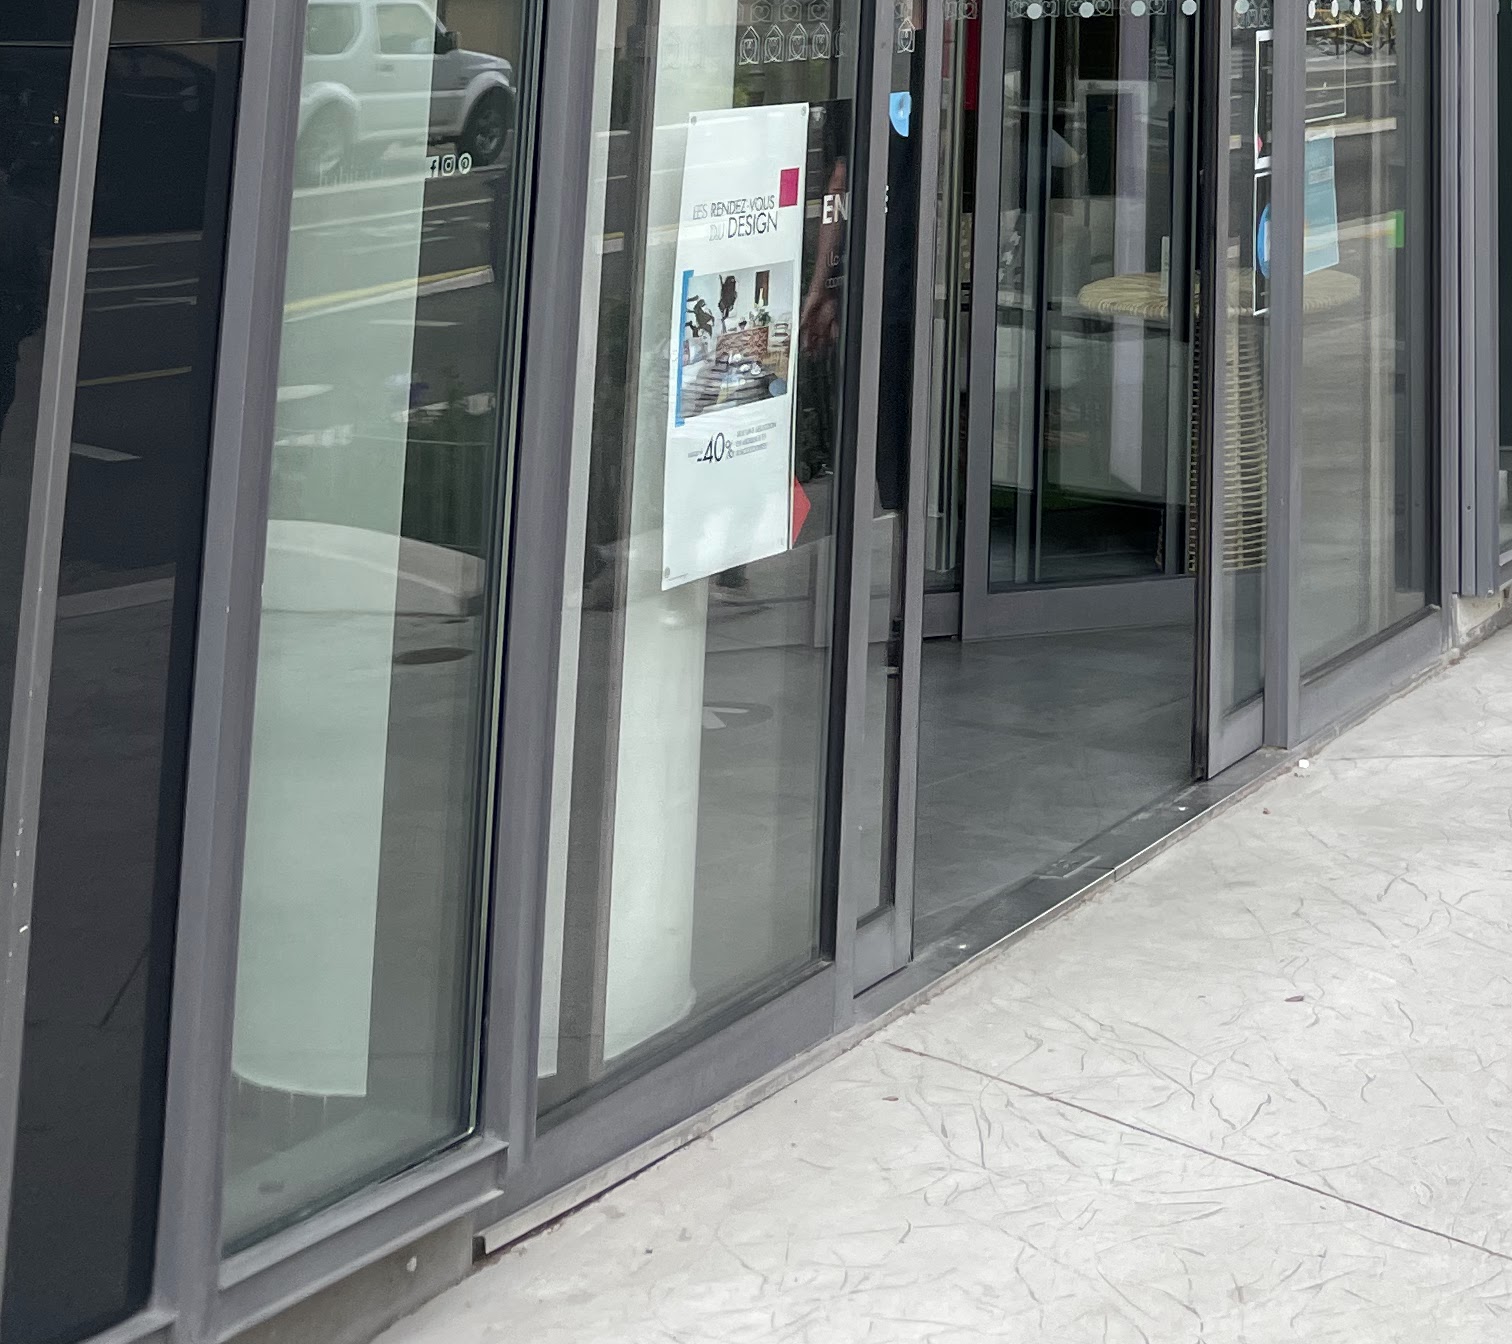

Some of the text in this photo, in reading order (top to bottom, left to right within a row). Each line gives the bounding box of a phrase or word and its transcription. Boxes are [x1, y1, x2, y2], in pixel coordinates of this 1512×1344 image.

[711, 195, 775, 217] RENDEZ-VOUS
[709, 211, 778, 241] DU DESIGN
